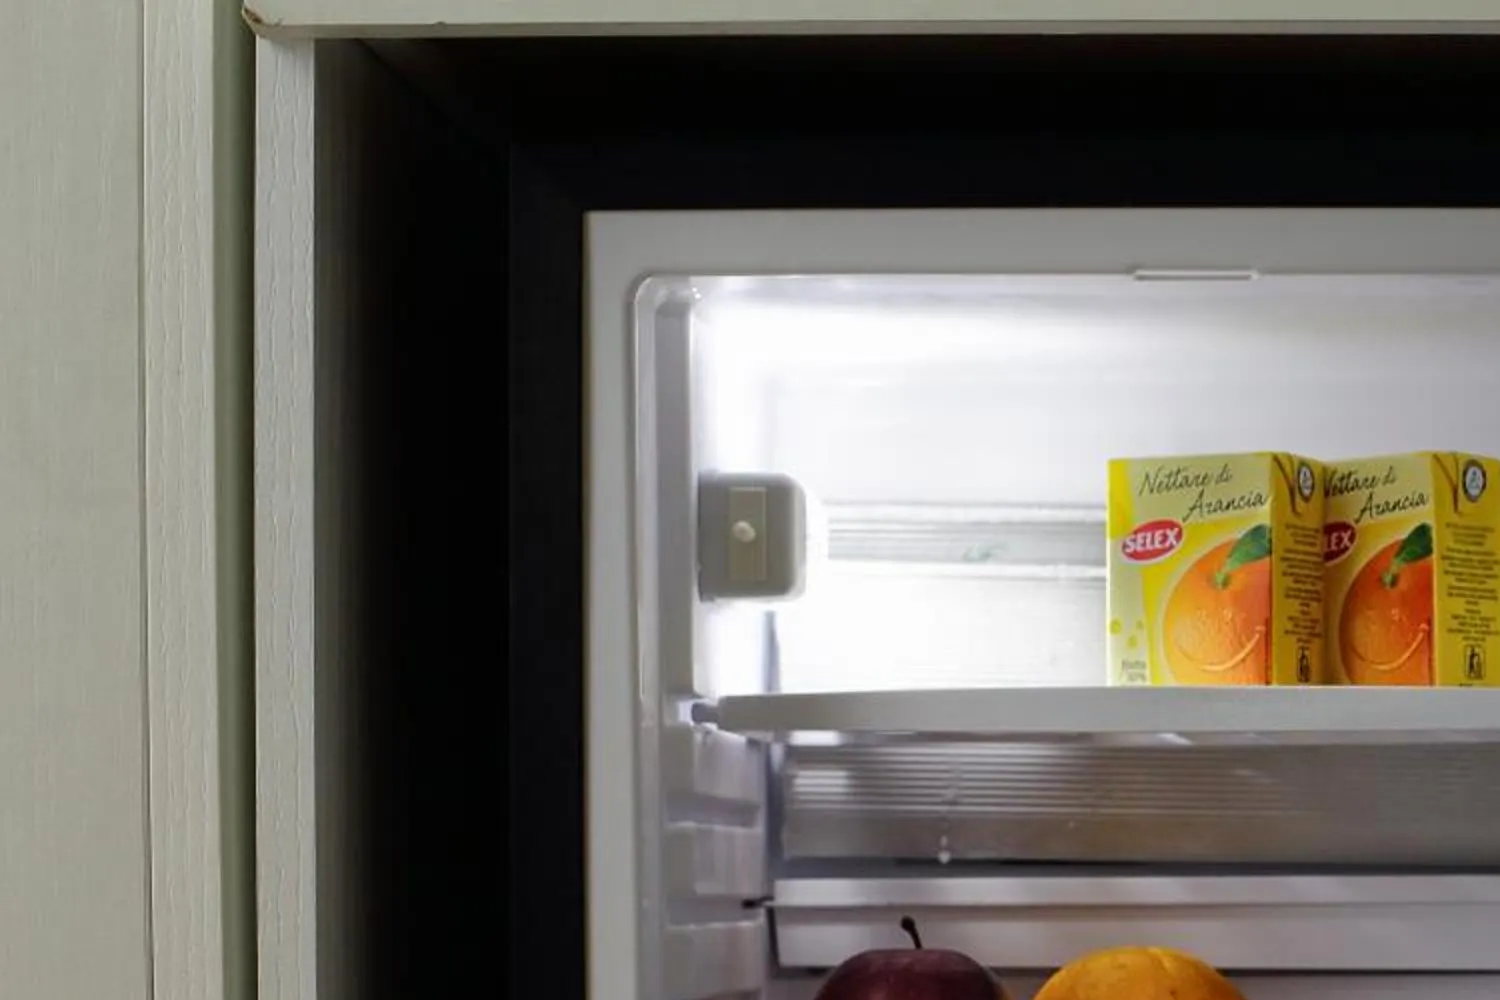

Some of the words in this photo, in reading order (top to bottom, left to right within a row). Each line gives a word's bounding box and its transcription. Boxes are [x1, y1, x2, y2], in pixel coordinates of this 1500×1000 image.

[1139, 464, 1211, 497] Nettare
[1215, 463, 1233, 485] di
[1381, 465, 1396, 487] di
[1181, 489, 1269, 523] Arancia
[1354, 490, 1429, 524] Arancia
[1123, 527, 1180, 553] SELEX
[1323, 528, 1353, 552] LEX
